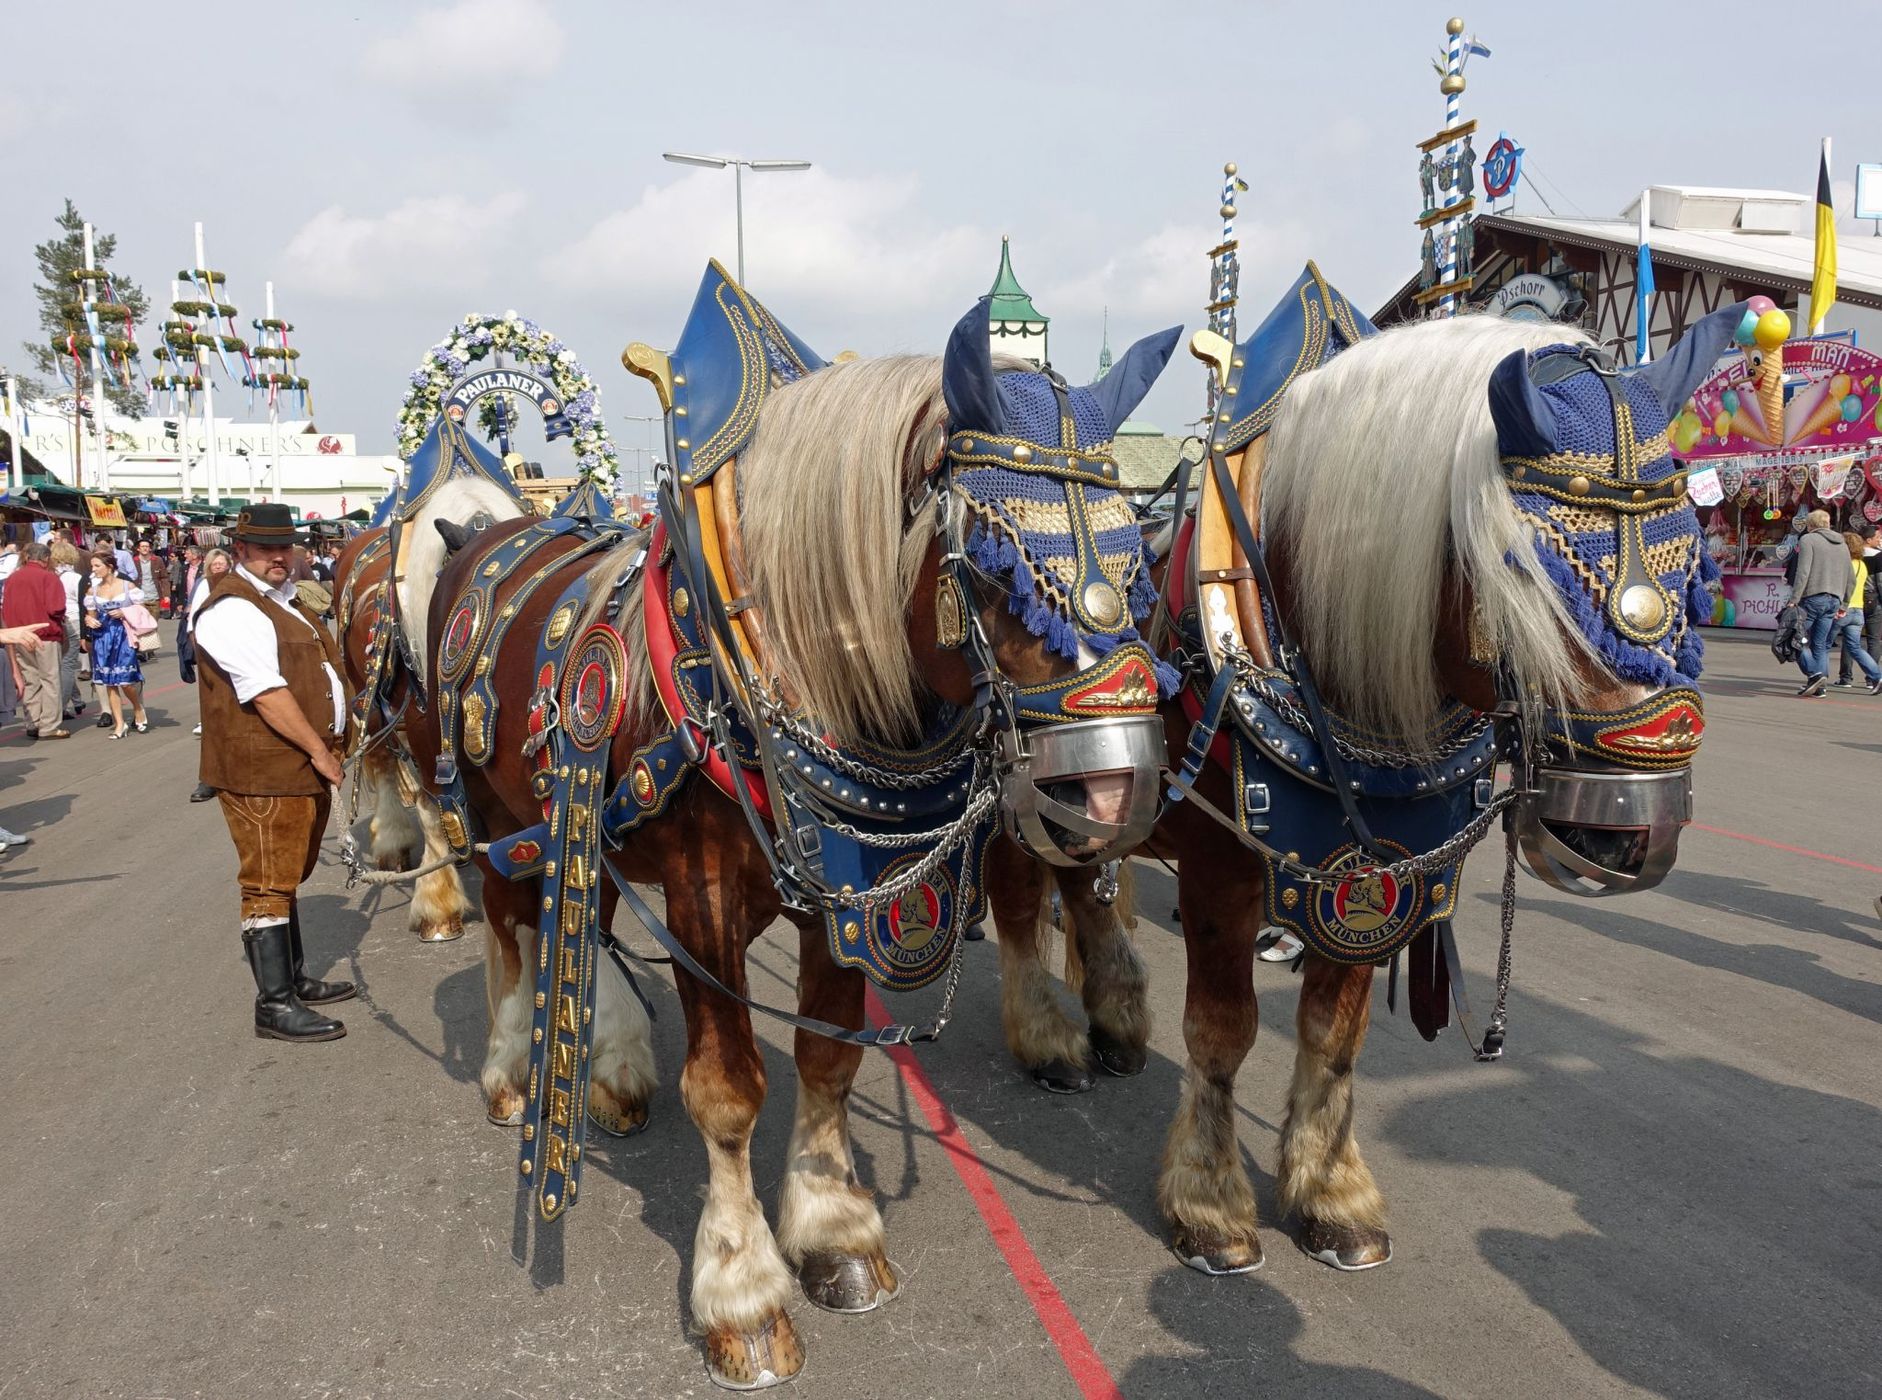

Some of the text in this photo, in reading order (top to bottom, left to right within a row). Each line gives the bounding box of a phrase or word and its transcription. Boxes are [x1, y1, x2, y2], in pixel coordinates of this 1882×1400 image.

[1498, 280, 1545, 308] Pschorr
[455, 373, 544, 405] PAULANER
[886, 926, 947, 962] MÜNCHEN
[1326, 915, 1401, 943] MÜNCHEN
[546, 803, 585, 1174] PAULANER
